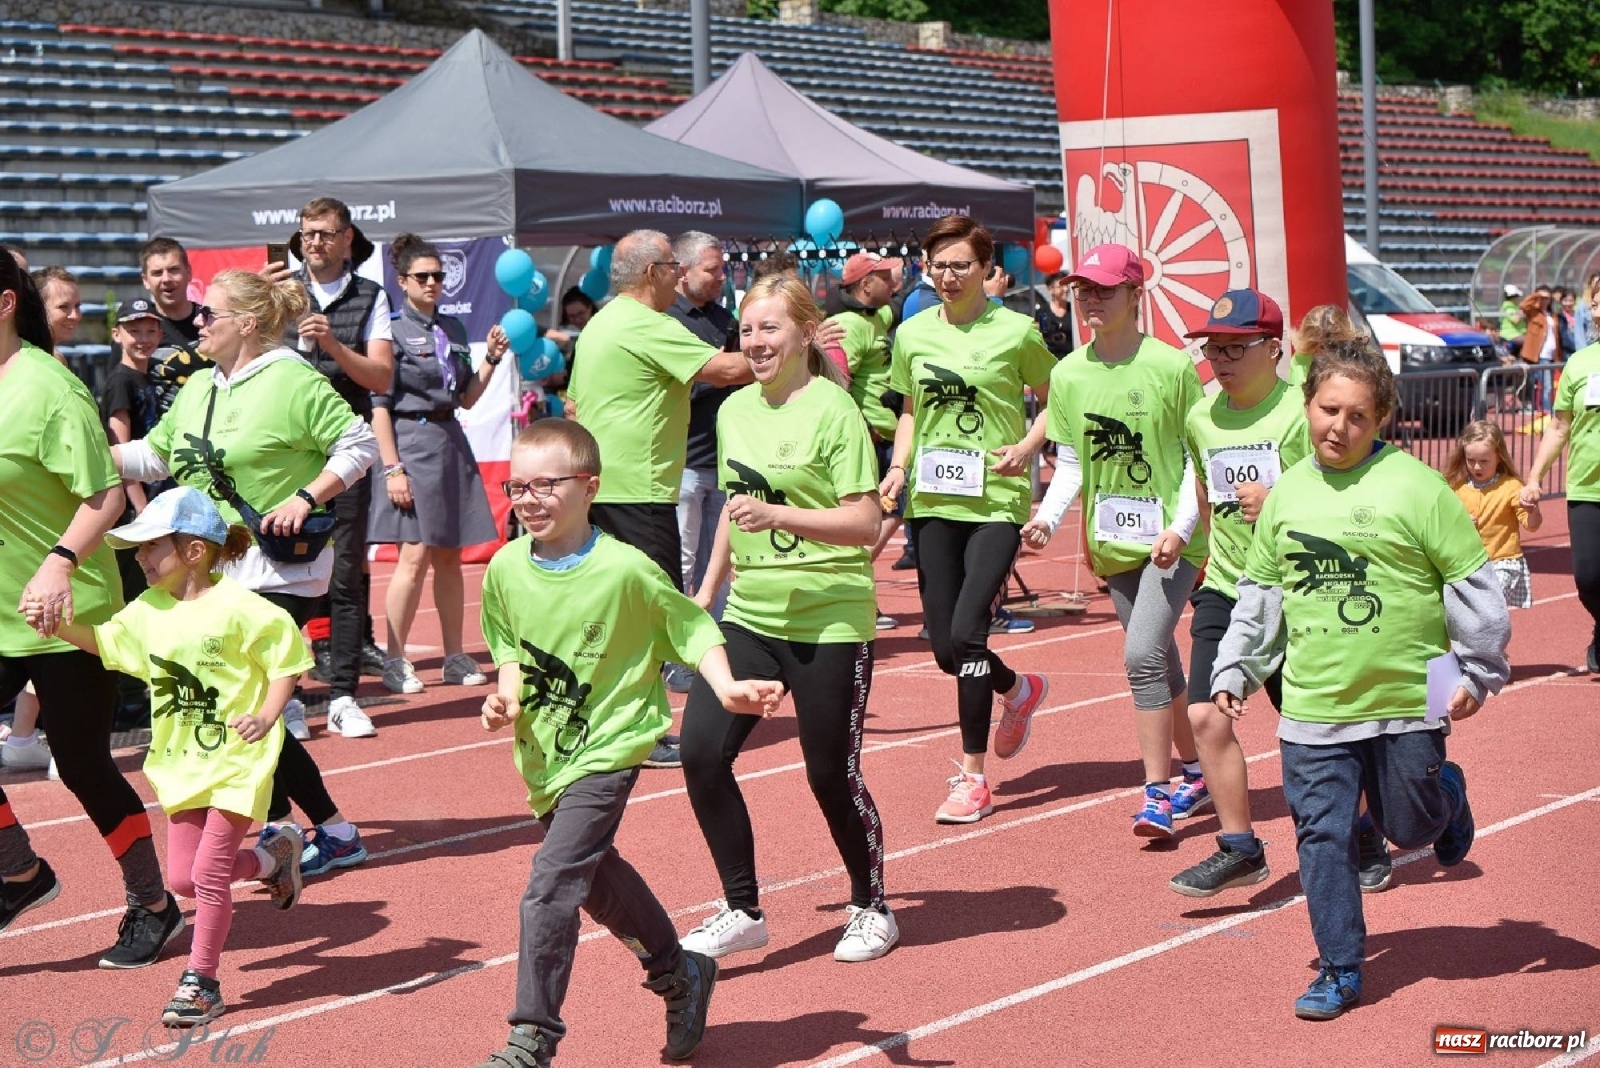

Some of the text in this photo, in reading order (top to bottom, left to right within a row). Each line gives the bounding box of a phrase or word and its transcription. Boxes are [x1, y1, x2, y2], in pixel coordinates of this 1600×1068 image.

[251, 200, 396, 226] www.orz.pl
[609, 195, 723, 218] www.raciborz.pl
[941, 385, 959, 394] VII
[1109, 434, 1125, 445] VII
[935, 464, 964, 480] 052
[1225, 464, 1259, 484] 060
[1116, 512, 1141, 528] 051
[1314, 559, 1340, 573] VII
